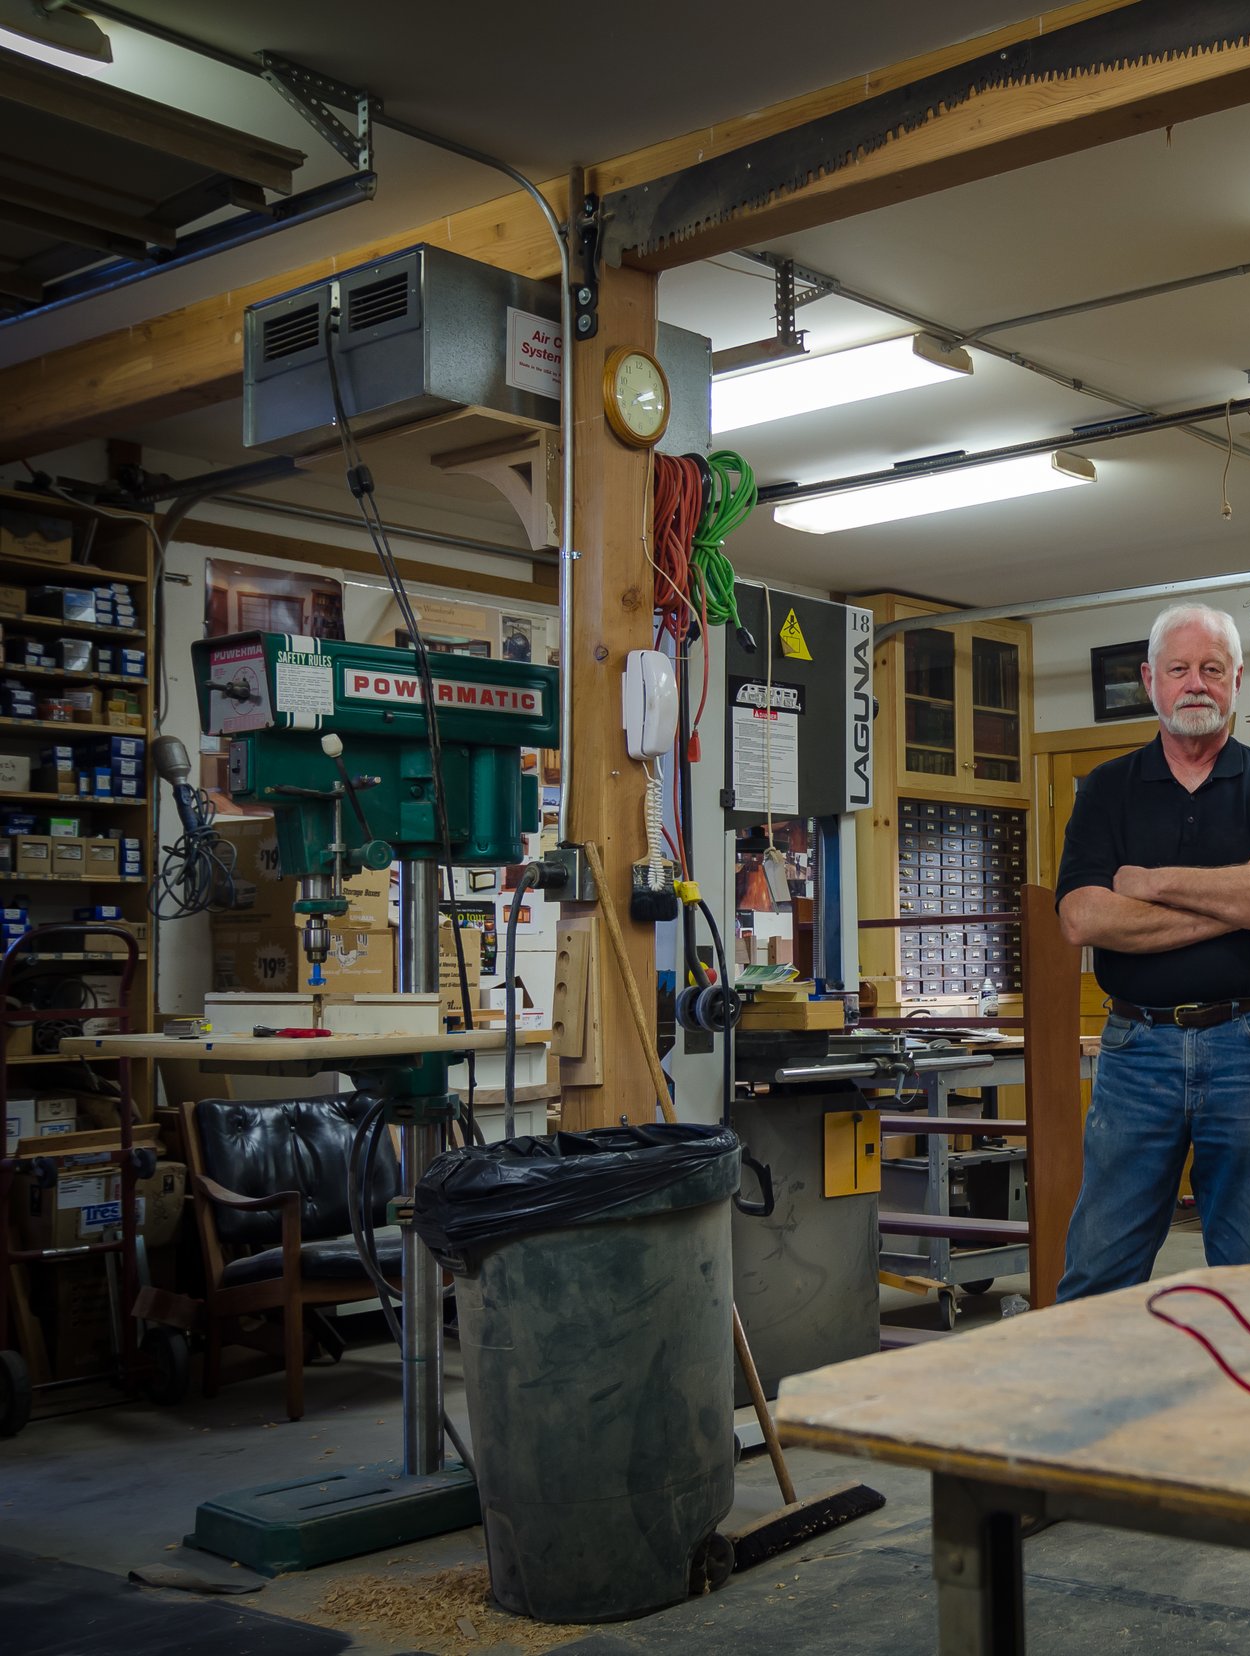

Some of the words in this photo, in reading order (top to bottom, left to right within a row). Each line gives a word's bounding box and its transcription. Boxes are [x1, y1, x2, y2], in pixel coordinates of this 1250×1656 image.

[532, 330, 550, 344] Air
[625, 364, 632, 374] 11
[635, 361, 643, 370] 12
[851, 612, 870, 633] 18
[277, 651, 306, 665] SAFETY
[308, 653, 332, 668] RULES
[354, 675, 535, 710] POWRMATIC
[849, 637, 870, 805] LAGUNA
[342, 888, 363, 897] Storage
[364, 888, 381, 897] Boxes
